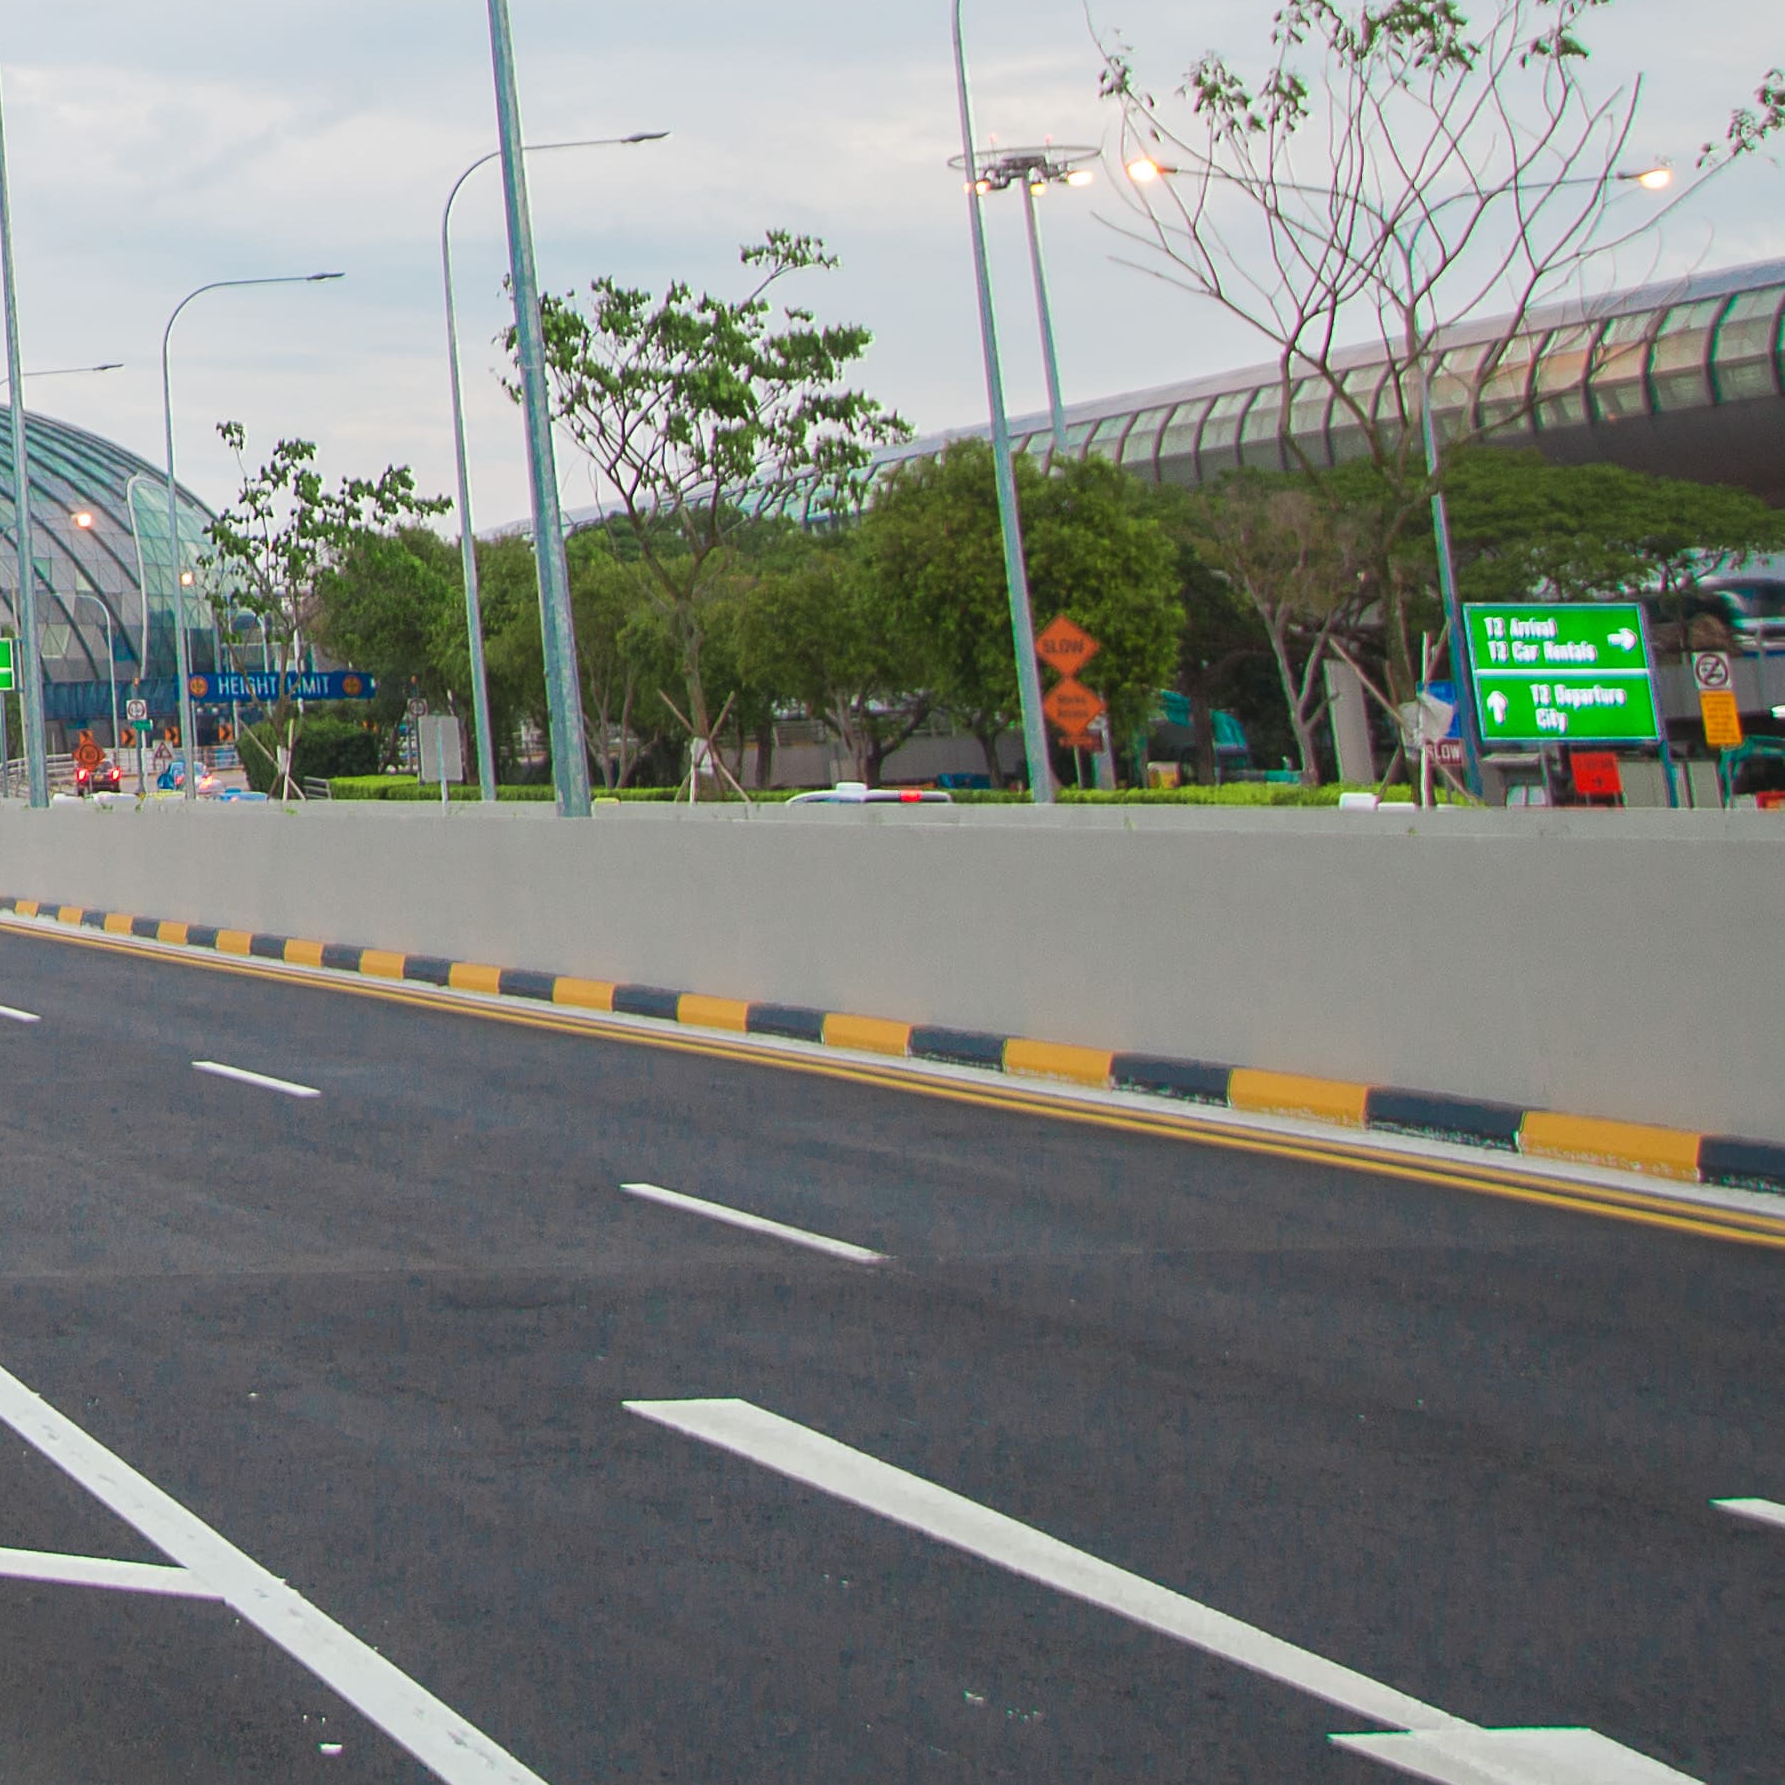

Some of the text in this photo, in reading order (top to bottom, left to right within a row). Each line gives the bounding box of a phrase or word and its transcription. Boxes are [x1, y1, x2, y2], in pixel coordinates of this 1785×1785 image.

[1510, 617, 1558, 638] Arrival
[1042, 638, 1085, 654] SLOW
[1512, 641, 1539, 662] Car
[1543, 641, 1598, 662] Rentals
[217, 675, 277, 695] HEIGHT
[1554, 684, 1627, 710] Departure
[1535, 708, 1568, 734] City
